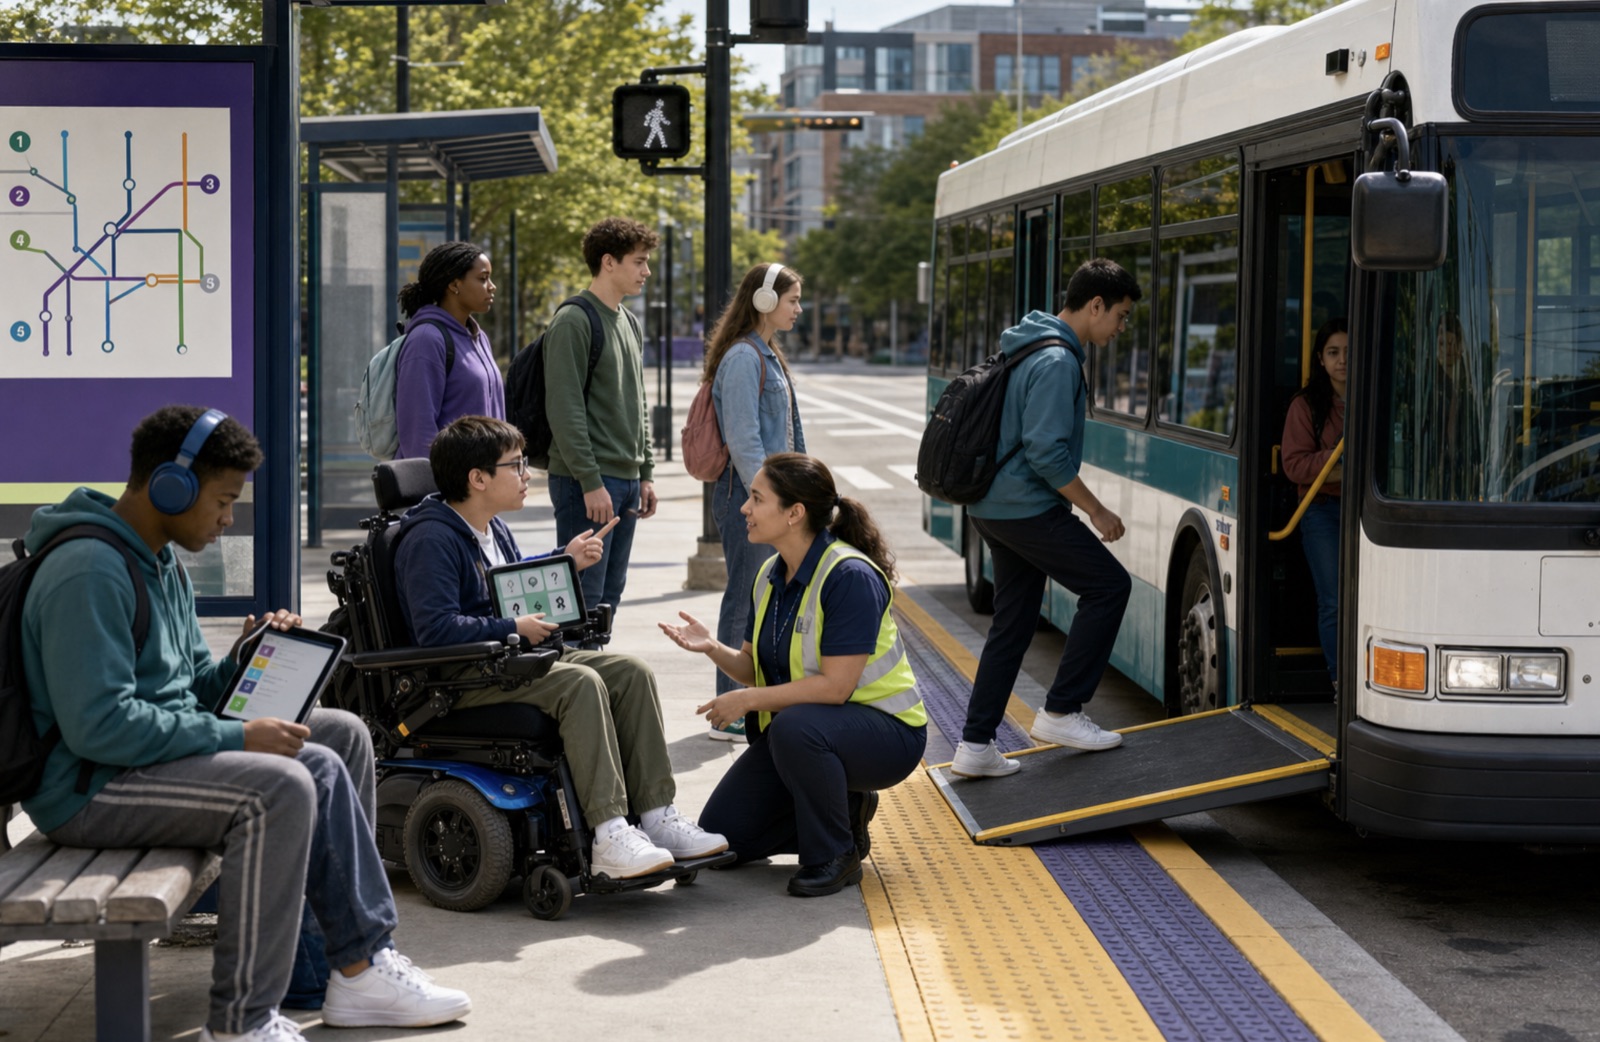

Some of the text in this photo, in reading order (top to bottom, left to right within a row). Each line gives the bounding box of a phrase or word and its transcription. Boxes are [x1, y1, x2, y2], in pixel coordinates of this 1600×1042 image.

[16, 135, 23, 148] 1
[206, 178, 214, 190] 3
[15, 190, 24, 202] 2
[16, 234, 25, 247] 4
